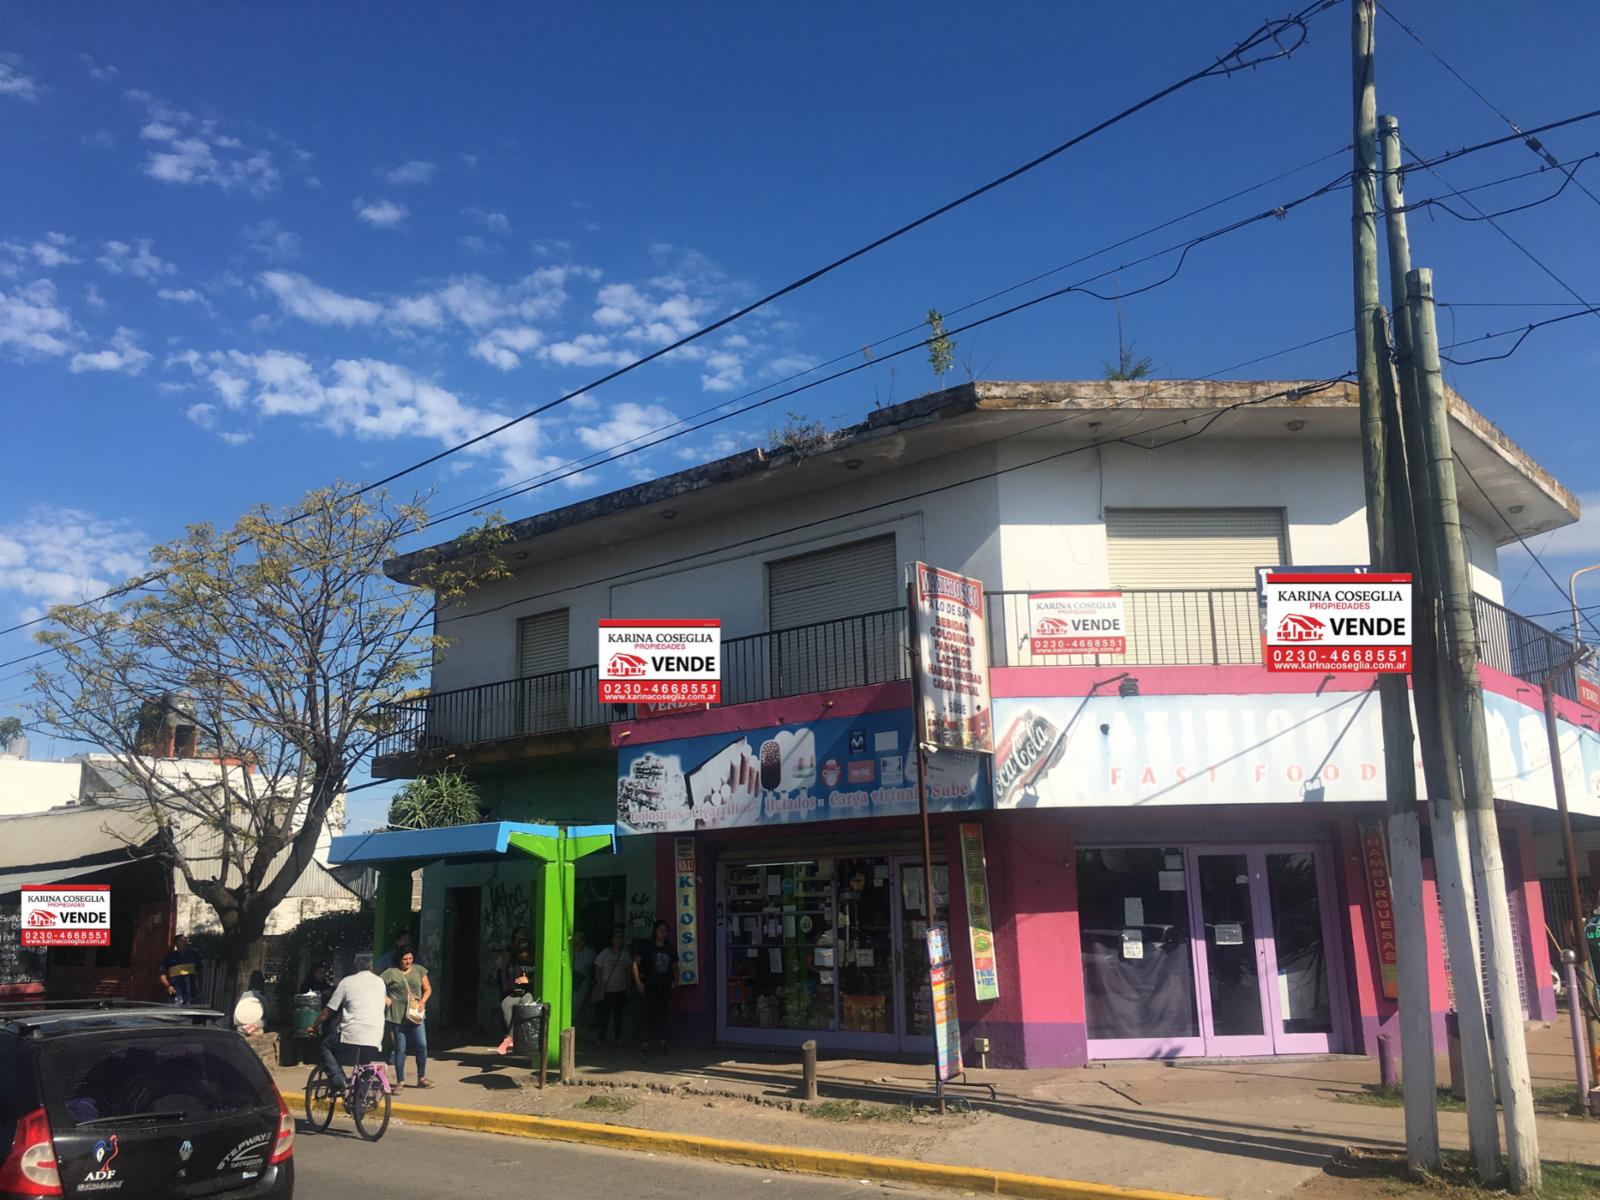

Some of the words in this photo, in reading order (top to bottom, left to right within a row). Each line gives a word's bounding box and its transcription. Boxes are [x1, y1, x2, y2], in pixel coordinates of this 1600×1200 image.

[1036, 602, 1072, 610] KARINA
[1073, 601, 1117, 609] COSEGLIA
[935, 616, 969, 634] BEBIDAS
[1071, 618, 1121, 631] VENDE
[930, 626, 976, 647] GOLOSINAS
[935, 640, 972, 658] PANCHOS
[1110, 764, 1219, 786] FAST
[1254, 762, 1377, 783] FOOD
[829, 790, 868, 808] Carga
[930, 783, 969, 799] Sube
[1367, 838, 1396, 961] HAMBURGUESAS
[678, 875, 695, 983] KIOSCO
[84, 1169, 117, 1182] ADF
